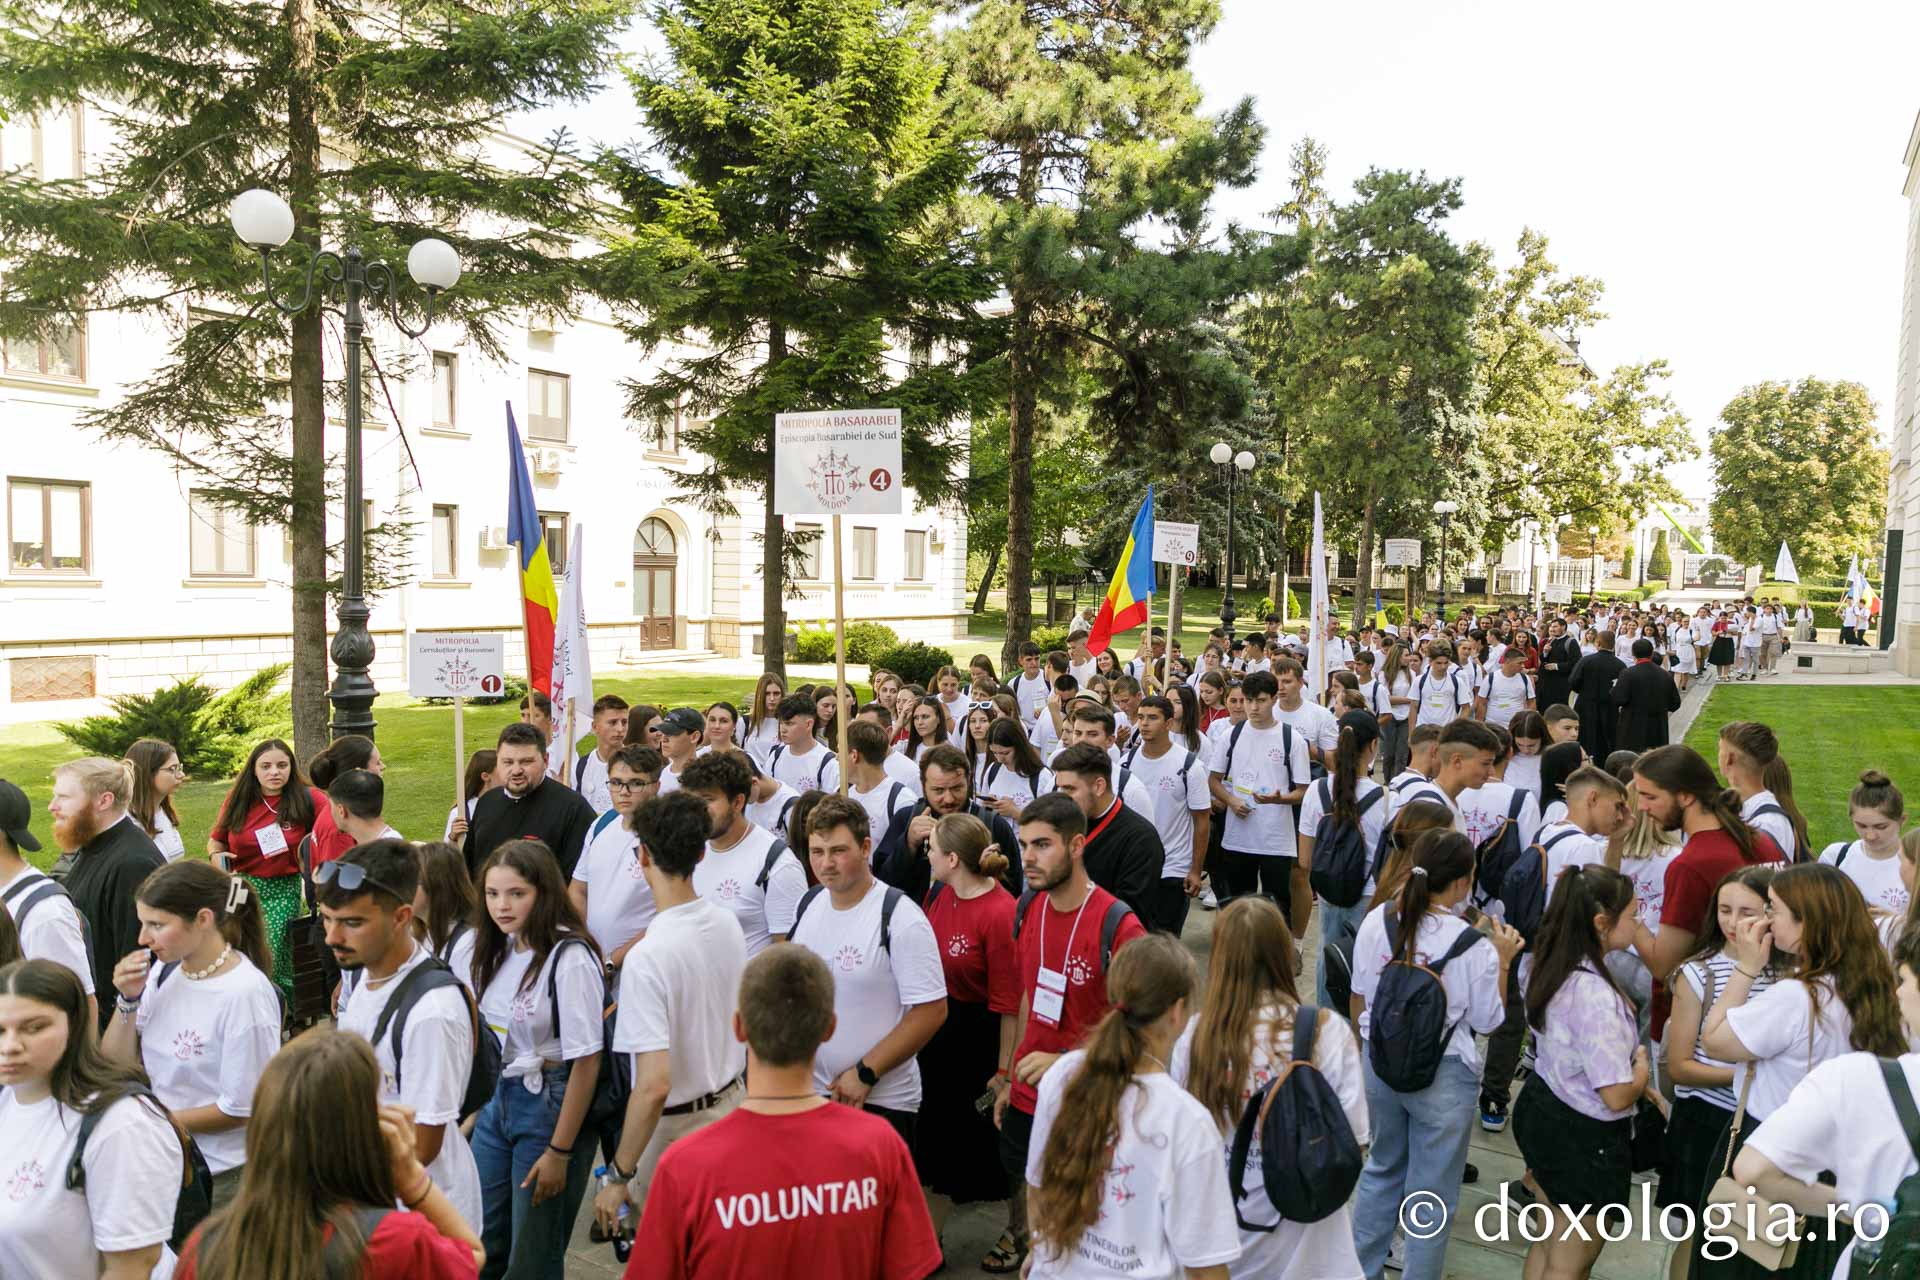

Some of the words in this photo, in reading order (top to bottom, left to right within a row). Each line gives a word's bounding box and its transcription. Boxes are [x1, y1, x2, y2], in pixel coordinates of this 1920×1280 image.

[781, 416, 832, 429] MITROPOLIA
[834, 415, 897, 427] BASARABIEI
[817, 431, 862, 441] Basarabiei
[864, 431, 876, 440] de
[879, 430, 897, 440] Sud
[872, 470, 888, 490] 4
[435, 637, 479, 645] MITROPOLIA
[714, 1176, 878, 1230] VOLUNTAR
[1086, 1231, 1136, 1257] TINERILOR
[1093, 1251, 1144, 1272] MOLDOVA
